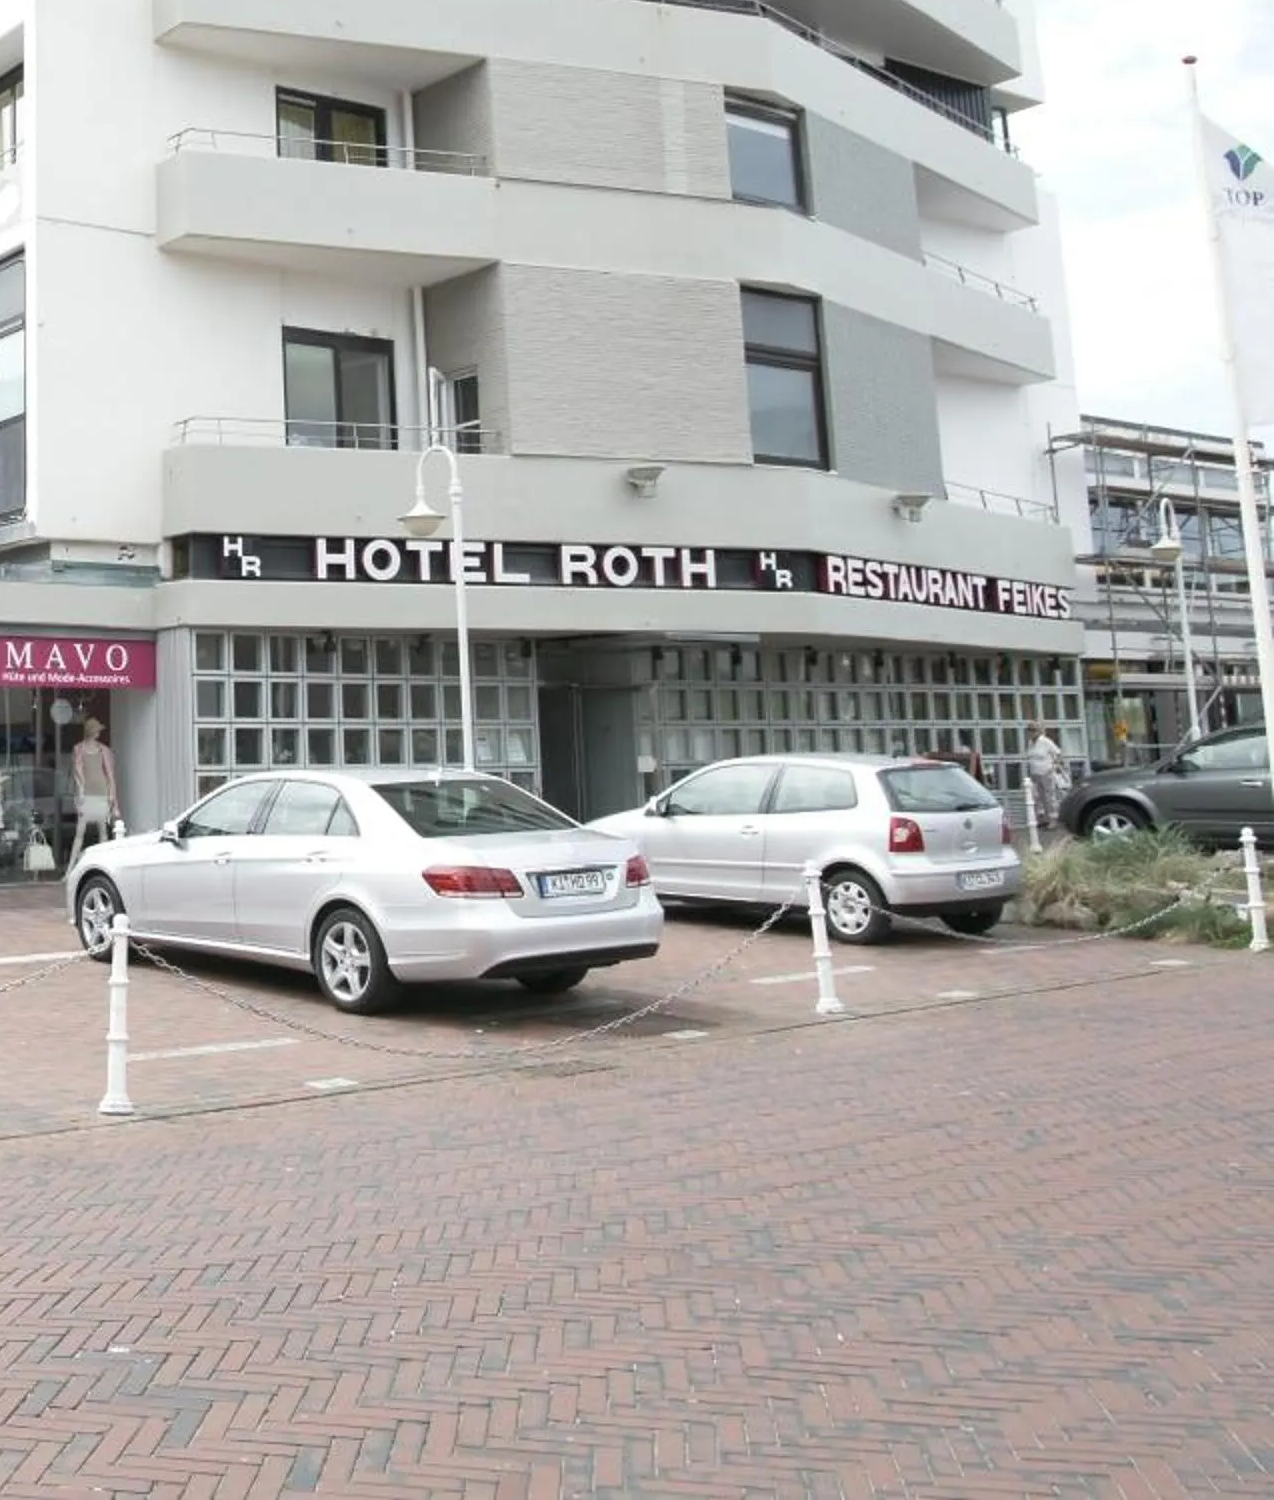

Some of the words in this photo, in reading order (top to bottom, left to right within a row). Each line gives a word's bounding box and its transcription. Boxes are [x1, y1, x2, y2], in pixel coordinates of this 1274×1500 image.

[316, 537, 531, 583] HOTEL
[560, 545, 716, 588] ROTH
[826, 555, 987, 610] RESTAURANT
[996, 579, 1072, 619] FEIKES
[6, 641, 128, 671] MAVO
[27, 672, 46, 682] und
